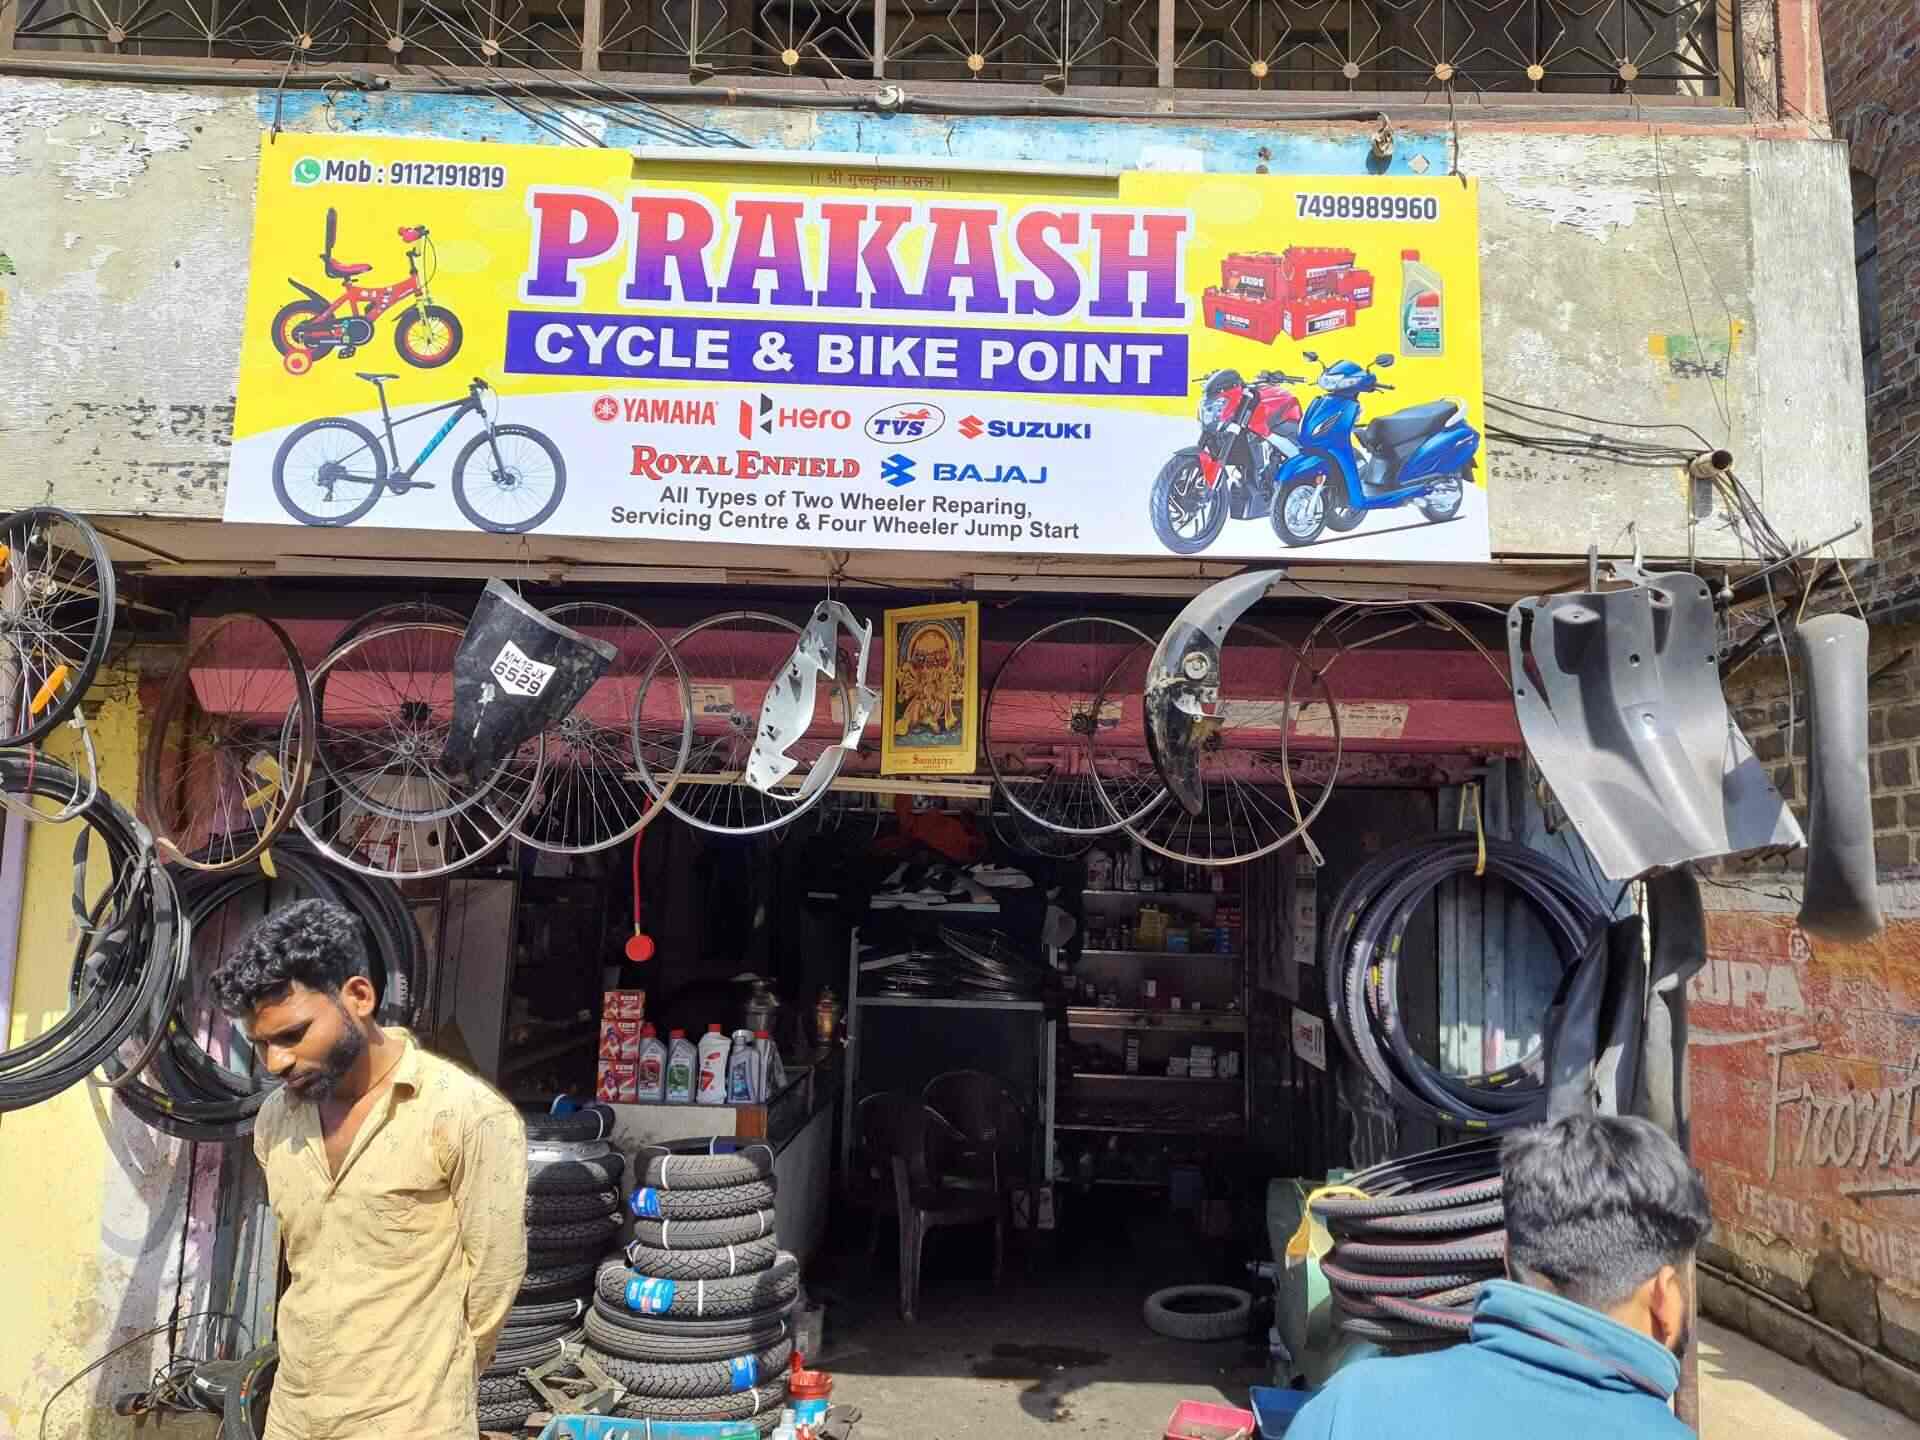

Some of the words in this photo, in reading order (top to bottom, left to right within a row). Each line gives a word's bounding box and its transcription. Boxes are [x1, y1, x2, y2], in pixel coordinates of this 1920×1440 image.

[326, 160, 371, 182] Mob
[391, 163, 504, 187] 9112191819
[1296, 195, 1437, 219] 7498989960
[525, 191, 1188, 319] PRAKASH
[534, 323, 730, 369] CYCLE
[752, 331, 794, 371] &
[817, 334, 959, 378] BIKE
[980, 340, 1163, 384] POINT
[624, 398, 717, 425] YAMAHA
[874, 419, 925, 436] TVS
[987, 420, 1091, 439] SUZUKI
[933, 463, 1048, 484] BAJAJ
[660, 486, 688, 504] All
[696, 487, 757, 509] Types
[770, 490, 786, 507] of
[792, 491, 834, 509] Two
[840, 492, 926, 513] Wheeler
[932, 496, 1032, 520] Reparing,
[611, 506, 711, 531] Servicing
[719, 510, 788, 529] Centre
[796, 513, 811, 531] &
[818, 514, 867, 532] Four
[873, 515, 959, 535] Wheeler
[965, 519, 1022, 540] Jump
[1030, 521, 1079, 539] Start
[493, 661, 542, 695] 6529
[1687, 959, 1805, 1015] UPA
